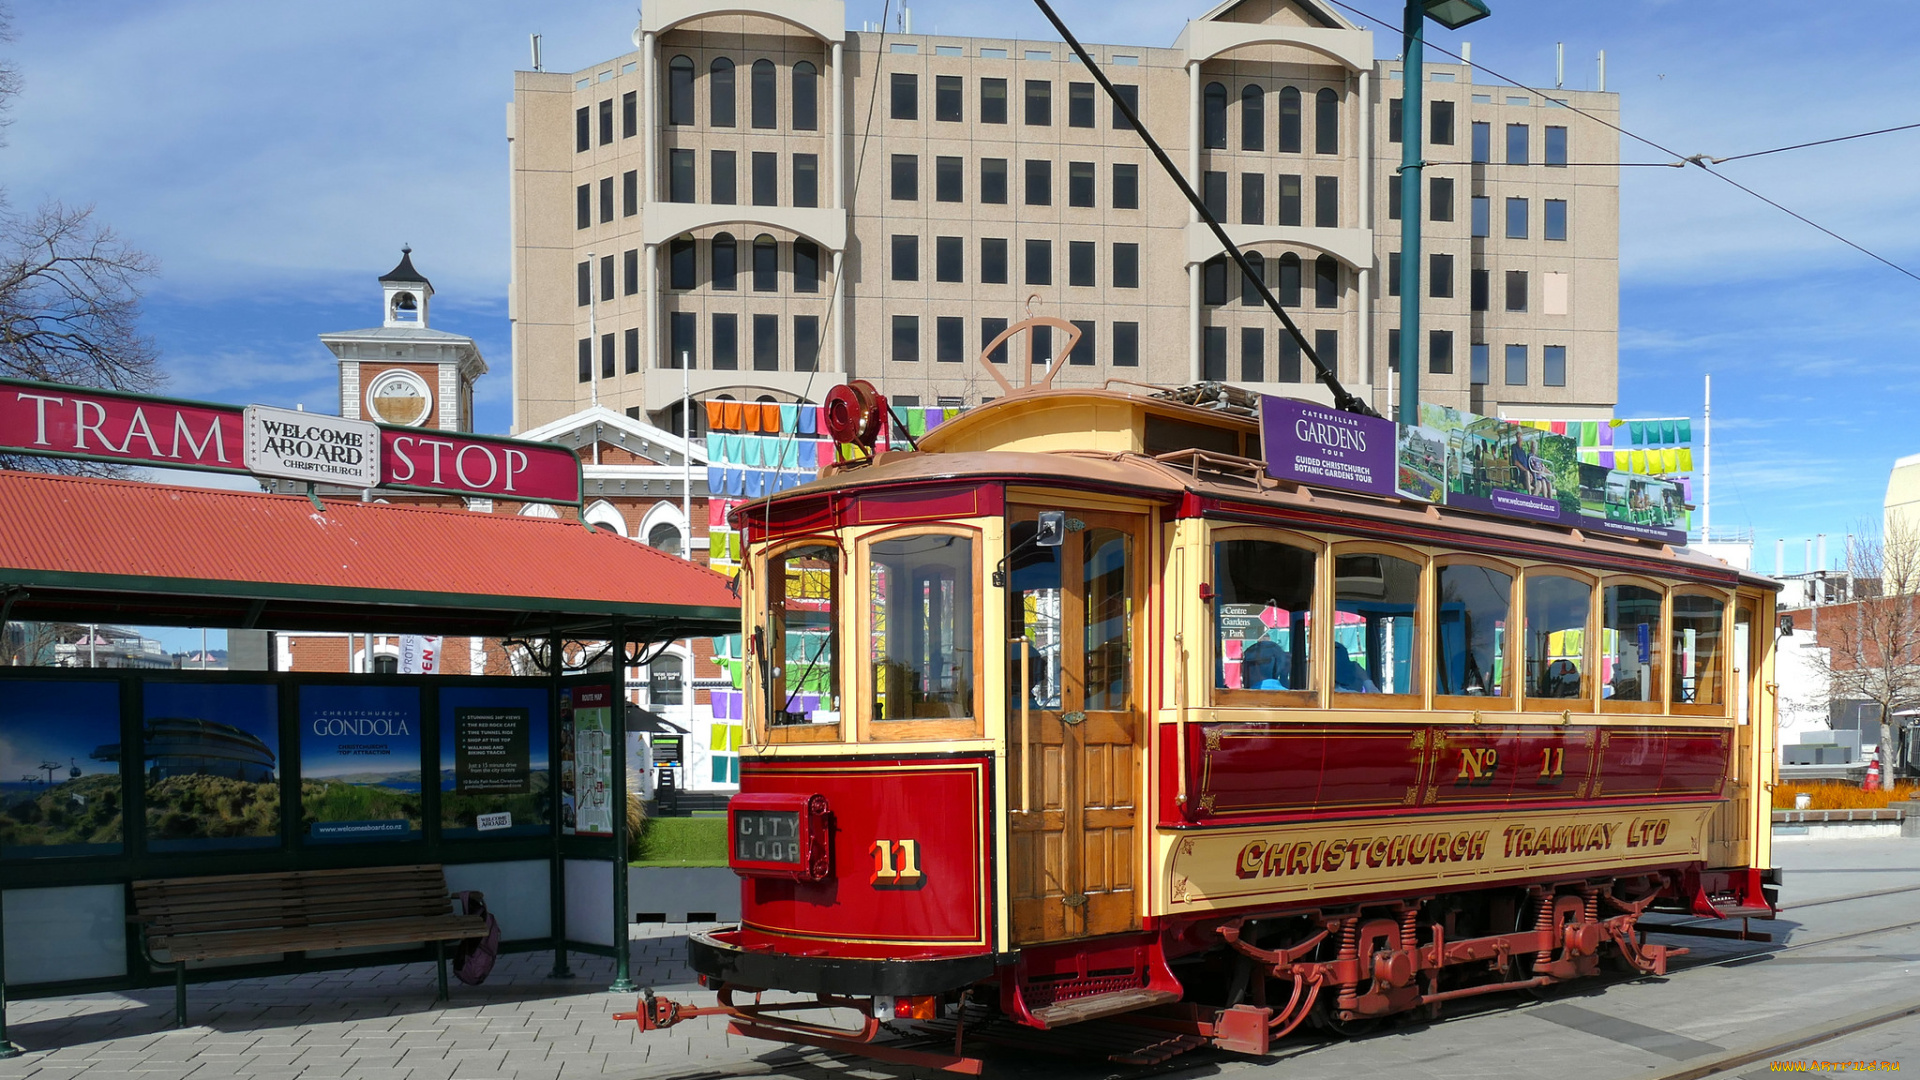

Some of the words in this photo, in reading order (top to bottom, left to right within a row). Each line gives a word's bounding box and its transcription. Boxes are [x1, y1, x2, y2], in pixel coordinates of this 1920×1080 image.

[1302, 410, 1358, 426] CATERPILLAR
[17, 392, 232, 463] TRAM
[392, 436, 528, 491] STOP
[262, 420, 362, 447] WELCOME
[1296, 419, 1366, 452] GARDENS
[262, 436, 362, 465] ABOARD
[1322, 448, 1344, 457] TOUR
[283, 459, 362, 476] CHRISTCHURCH
[1294, 463, 1323, 475] BOTANIC
[1325, 469, 1354, 480] GARDENS
[1355, 474, 1372, 483] TOUR
[1296, 455, 1320, 466] GUIDED
[1322, 460, 1370, 475] CHRISTCHURCH
[422, 650, 434, 674] EN
[313, 719, 410, 736] GONDOLA
[1538, 747, 1564, 778] 11
[741, 816, 799, 837] CITY
[741, 840, 799, 861] LOOP
[870, 839, 922, 884] 11
[1236, 830, 1490, 879] CHRISTCHURCH
[1503, 822, 1622, 858] TRAMWAY
